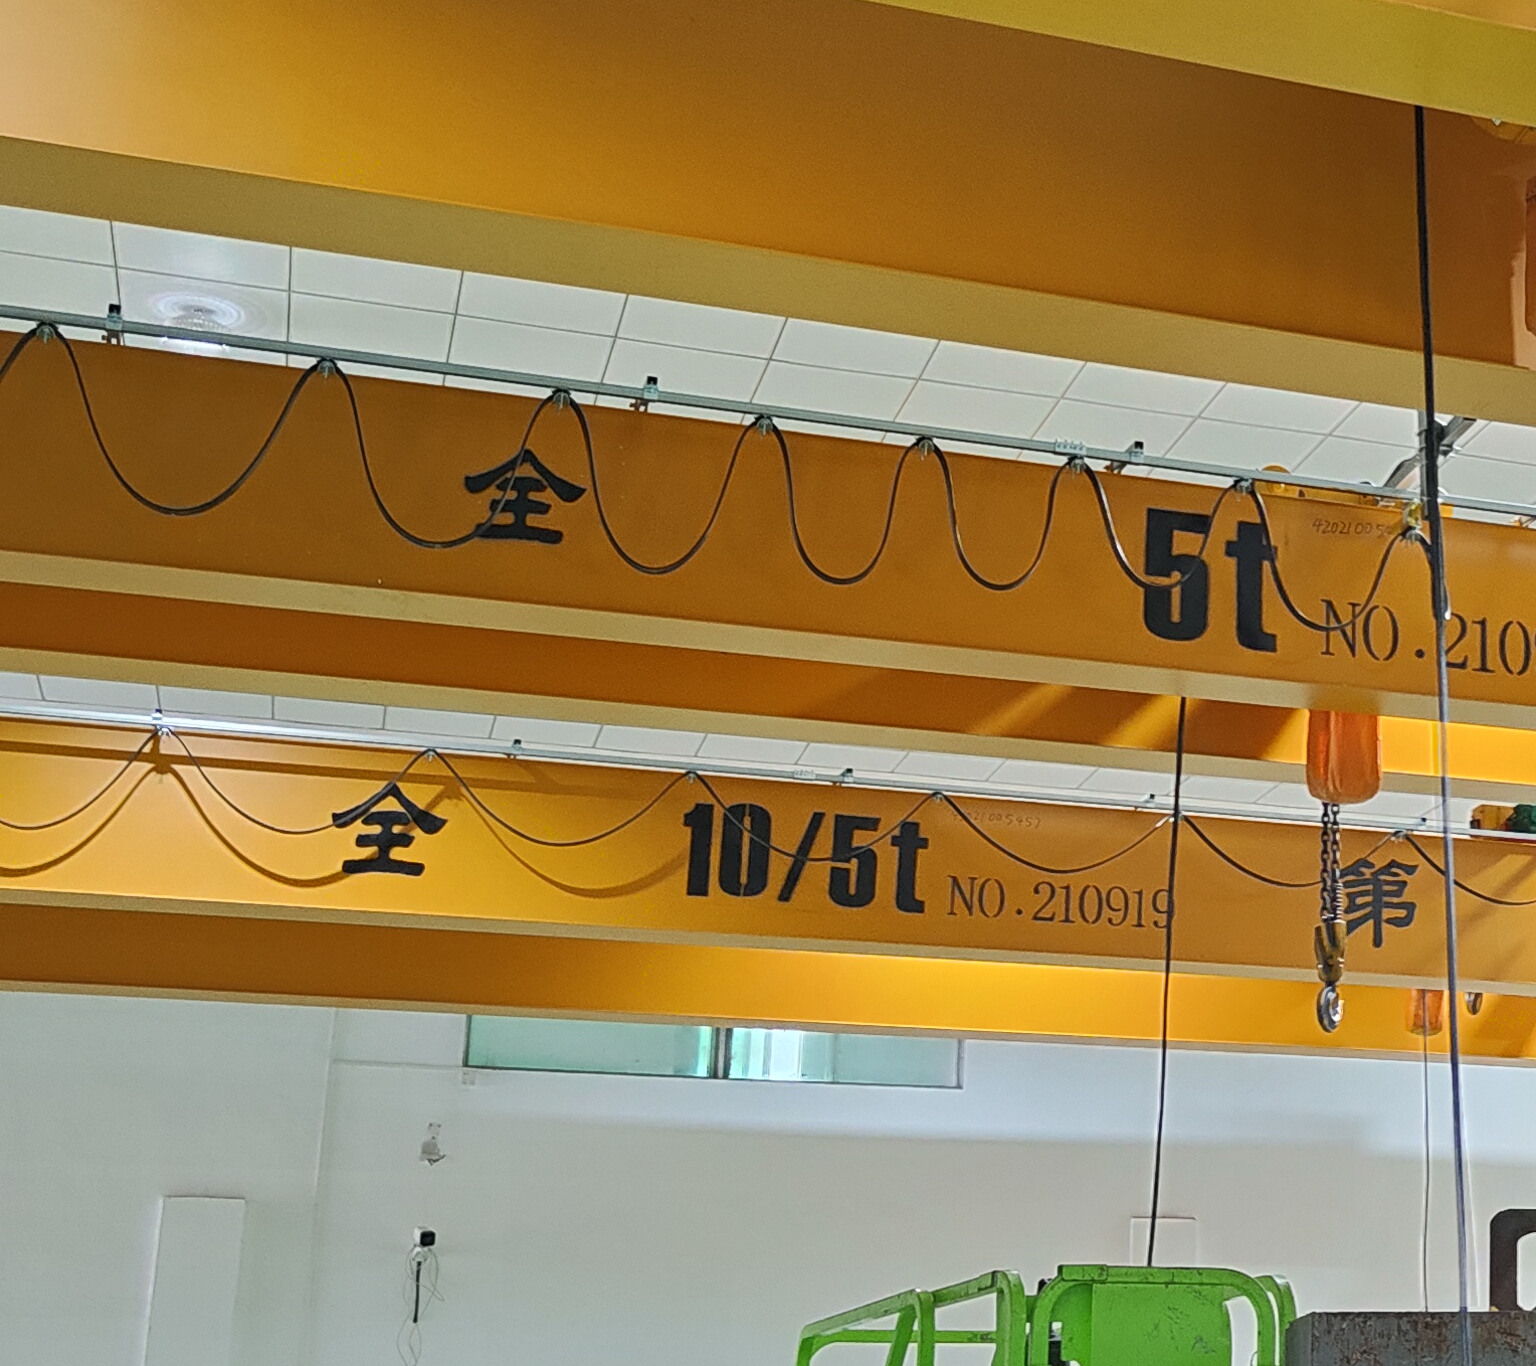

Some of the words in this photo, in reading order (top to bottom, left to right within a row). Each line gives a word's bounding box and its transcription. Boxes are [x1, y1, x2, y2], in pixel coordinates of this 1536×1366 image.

[463, 448, 587, 545] 全
[1142, 506, 1279, 654] 5t
[331, 781, 448, 877] 全
[683, 802, 929, 914] 10/5t
[946, 874, 1174, 929] NO.210919
[1339, 857, 1420, 949] 第
